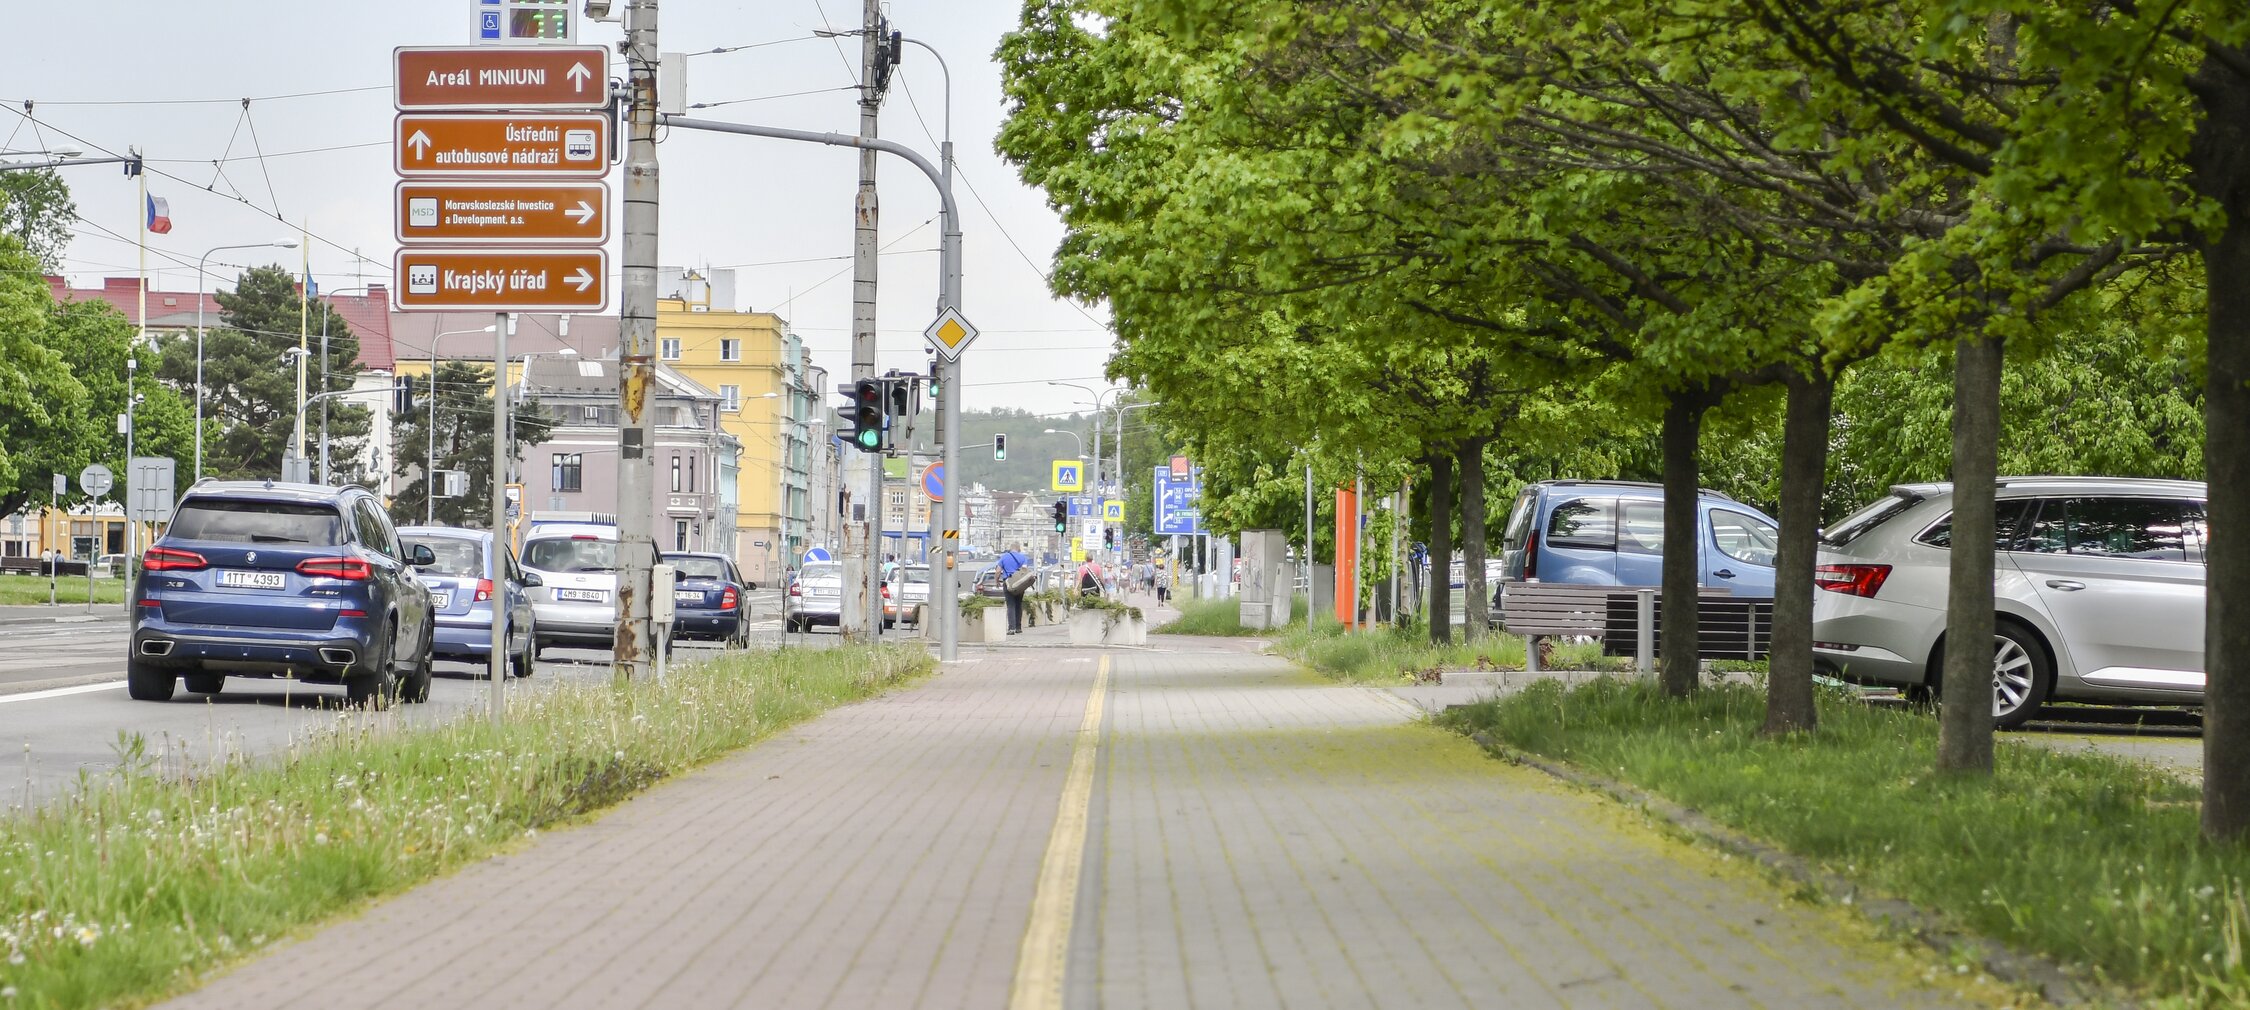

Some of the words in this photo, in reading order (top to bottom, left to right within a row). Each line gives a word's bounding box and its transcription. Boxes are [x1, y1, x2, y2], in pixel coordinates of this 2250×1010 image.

[426, 69, 471, 86] Areál
[479, 69, 545, 86] MINIUNI
[506, 122, 558, 142] Ústřední
[436, 148, 508, 164] autobusové
[512, 148, 558, 164] nádraží
[445, 199, 515, 211] Moravskoslezské
[517, 200, 554, 211] Investice
[445, 216, 451, 225] a
[510, 216, 525, 225] a.s.
[444, 269, 505, 294] Krajský
[510, 269, 546, 290] úřad
[226, 573, 245, 584] 1TT
[253, 573, 280, 586] 4393
[564, 590, 577, 599] 4M9
[582, 591, 600, 600] 8640
